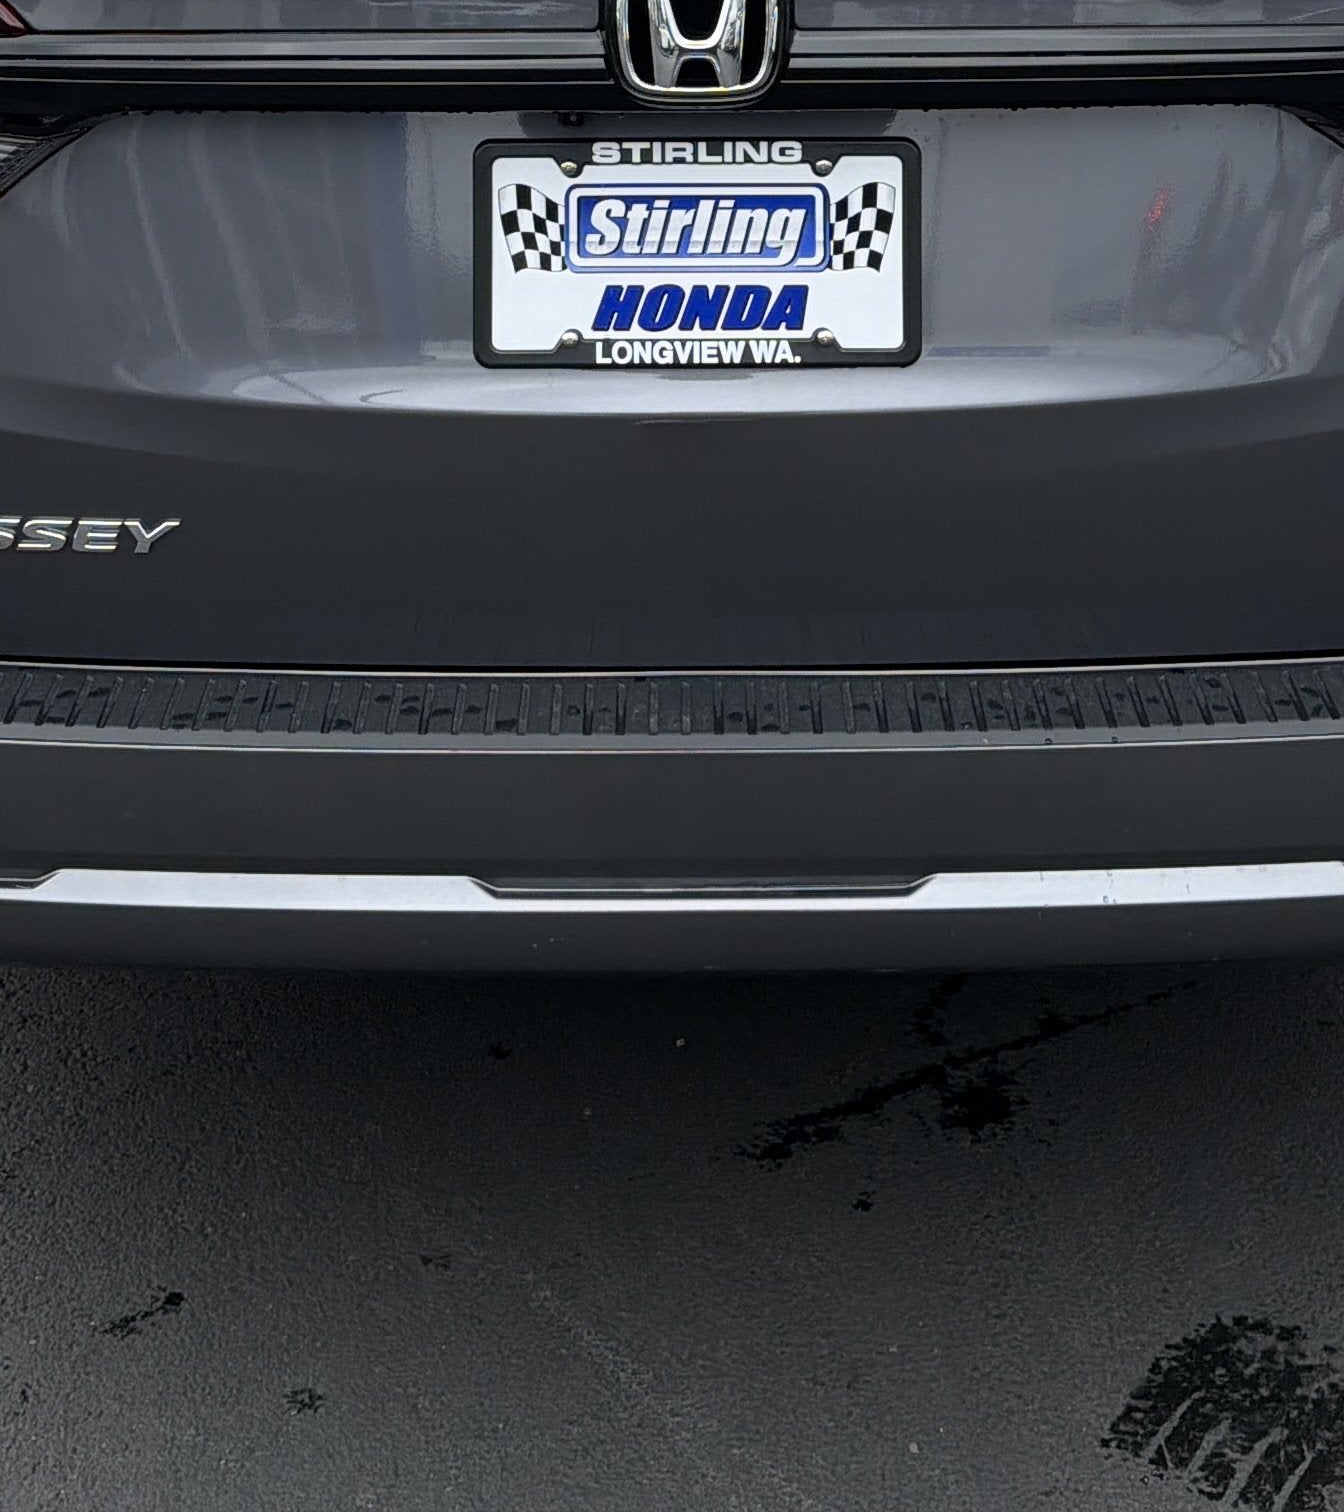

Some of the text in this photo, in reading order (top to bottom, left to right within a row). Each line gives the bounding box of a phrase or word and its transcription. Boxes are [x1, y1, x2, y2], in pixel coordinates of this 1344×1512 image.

[592, 141, 802, 163] STIRLING
[586, 199, 808, 267] Stirling
[592, 285, 810, 332] HONDA
[595, 342, 801, 364] LONGVIEW WA.
